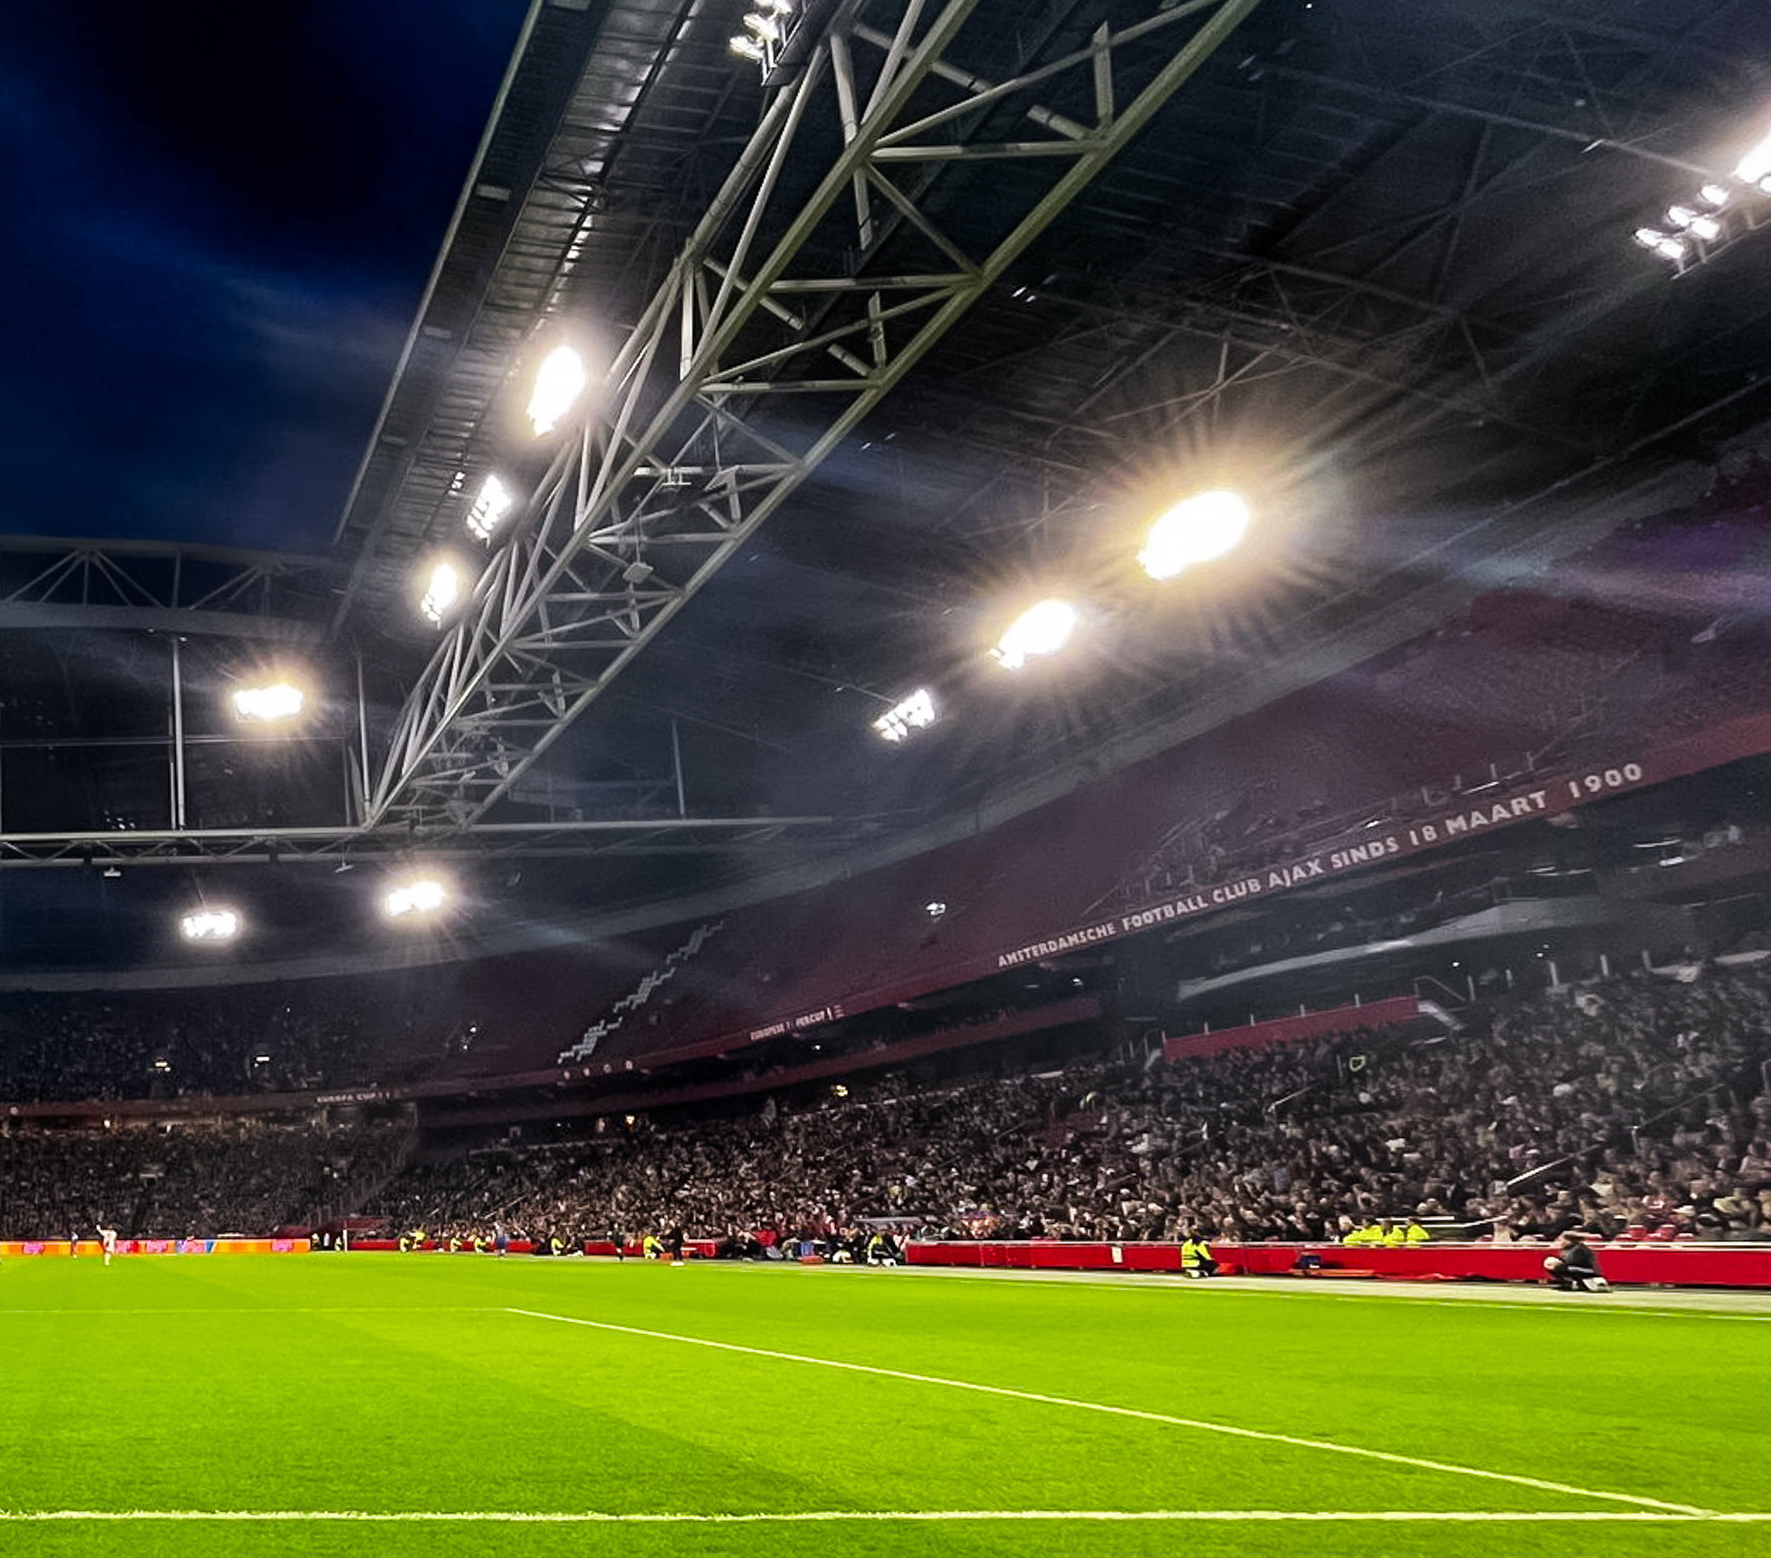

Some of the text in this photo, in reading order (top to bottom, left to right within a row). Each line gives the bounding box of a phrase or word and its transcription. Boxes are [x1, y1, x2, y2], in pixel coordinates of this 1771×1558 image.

[997, 763, 1643, 968] AMSTERDAMSCHE FOOTBALL CLUB AJAX SINDS 18 MAART 1900
